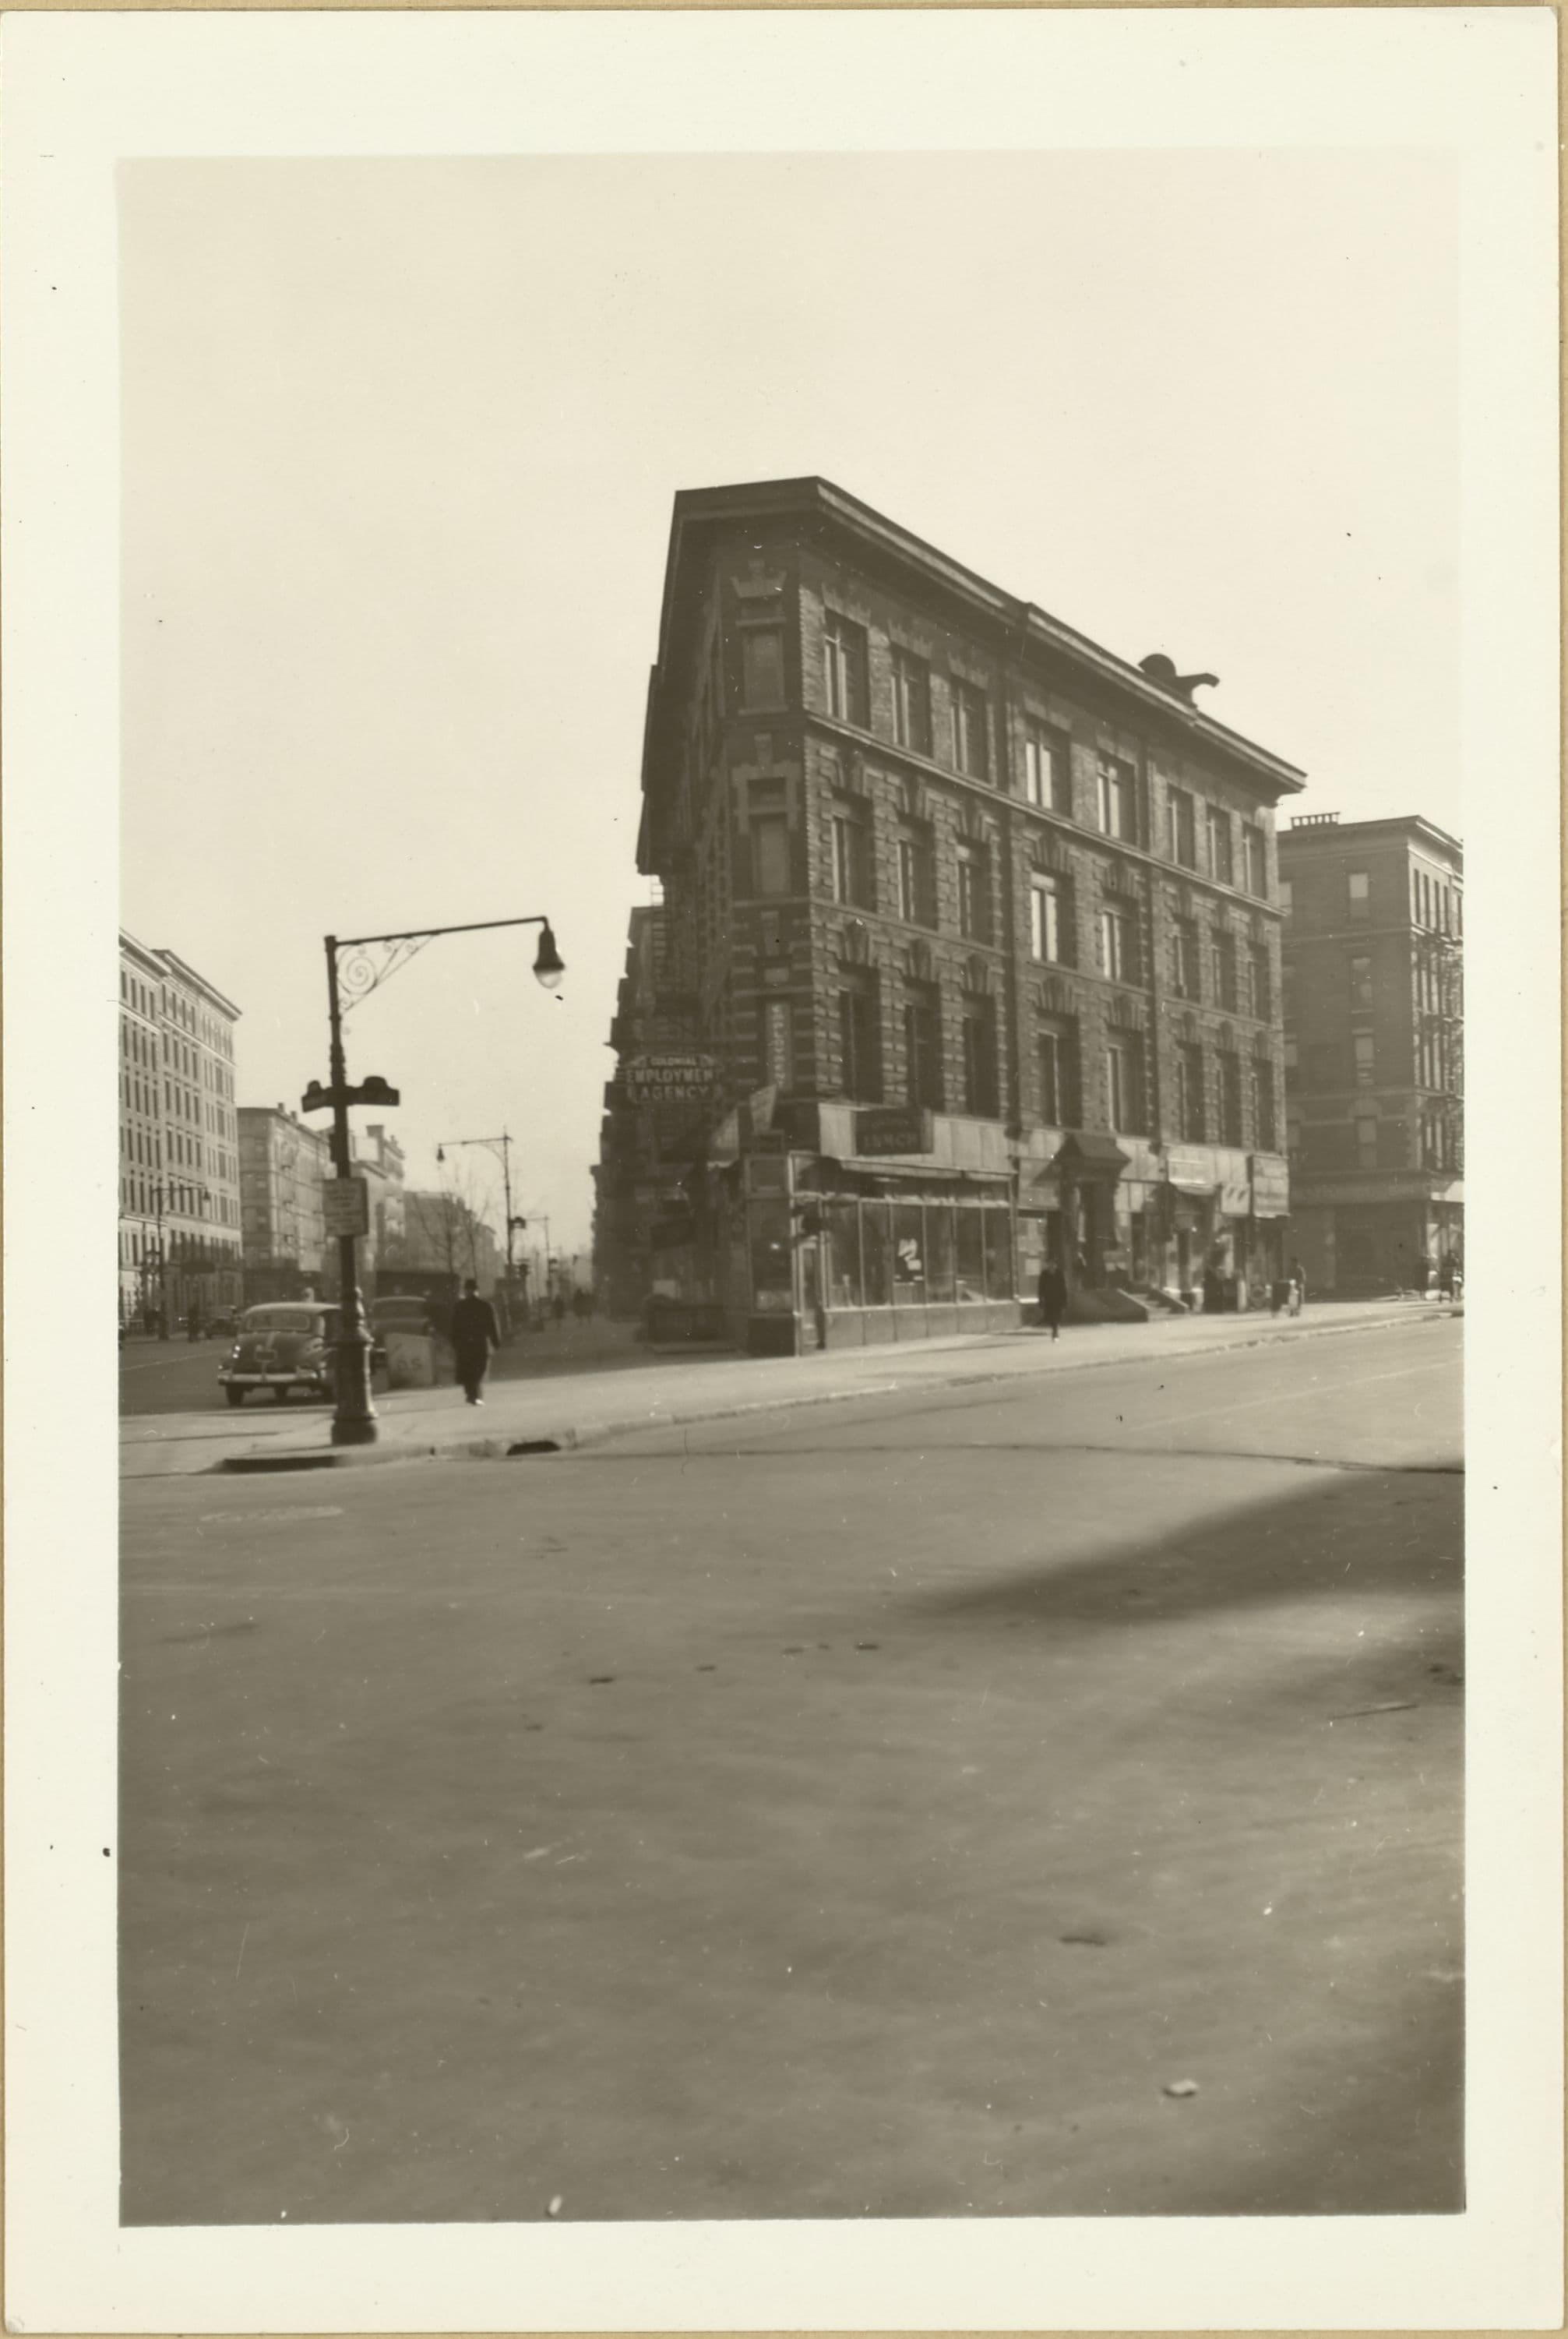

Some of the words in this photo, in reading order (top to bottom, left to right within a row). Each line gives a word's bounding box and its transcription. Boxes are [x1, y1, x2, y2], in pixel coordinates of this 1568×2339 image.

[626, 1068, 724, 1082] EMPLOYMENT
[640, 1085, 710, 1099] AGENCY
[863, 1134, 918, 1147] LUNCH
